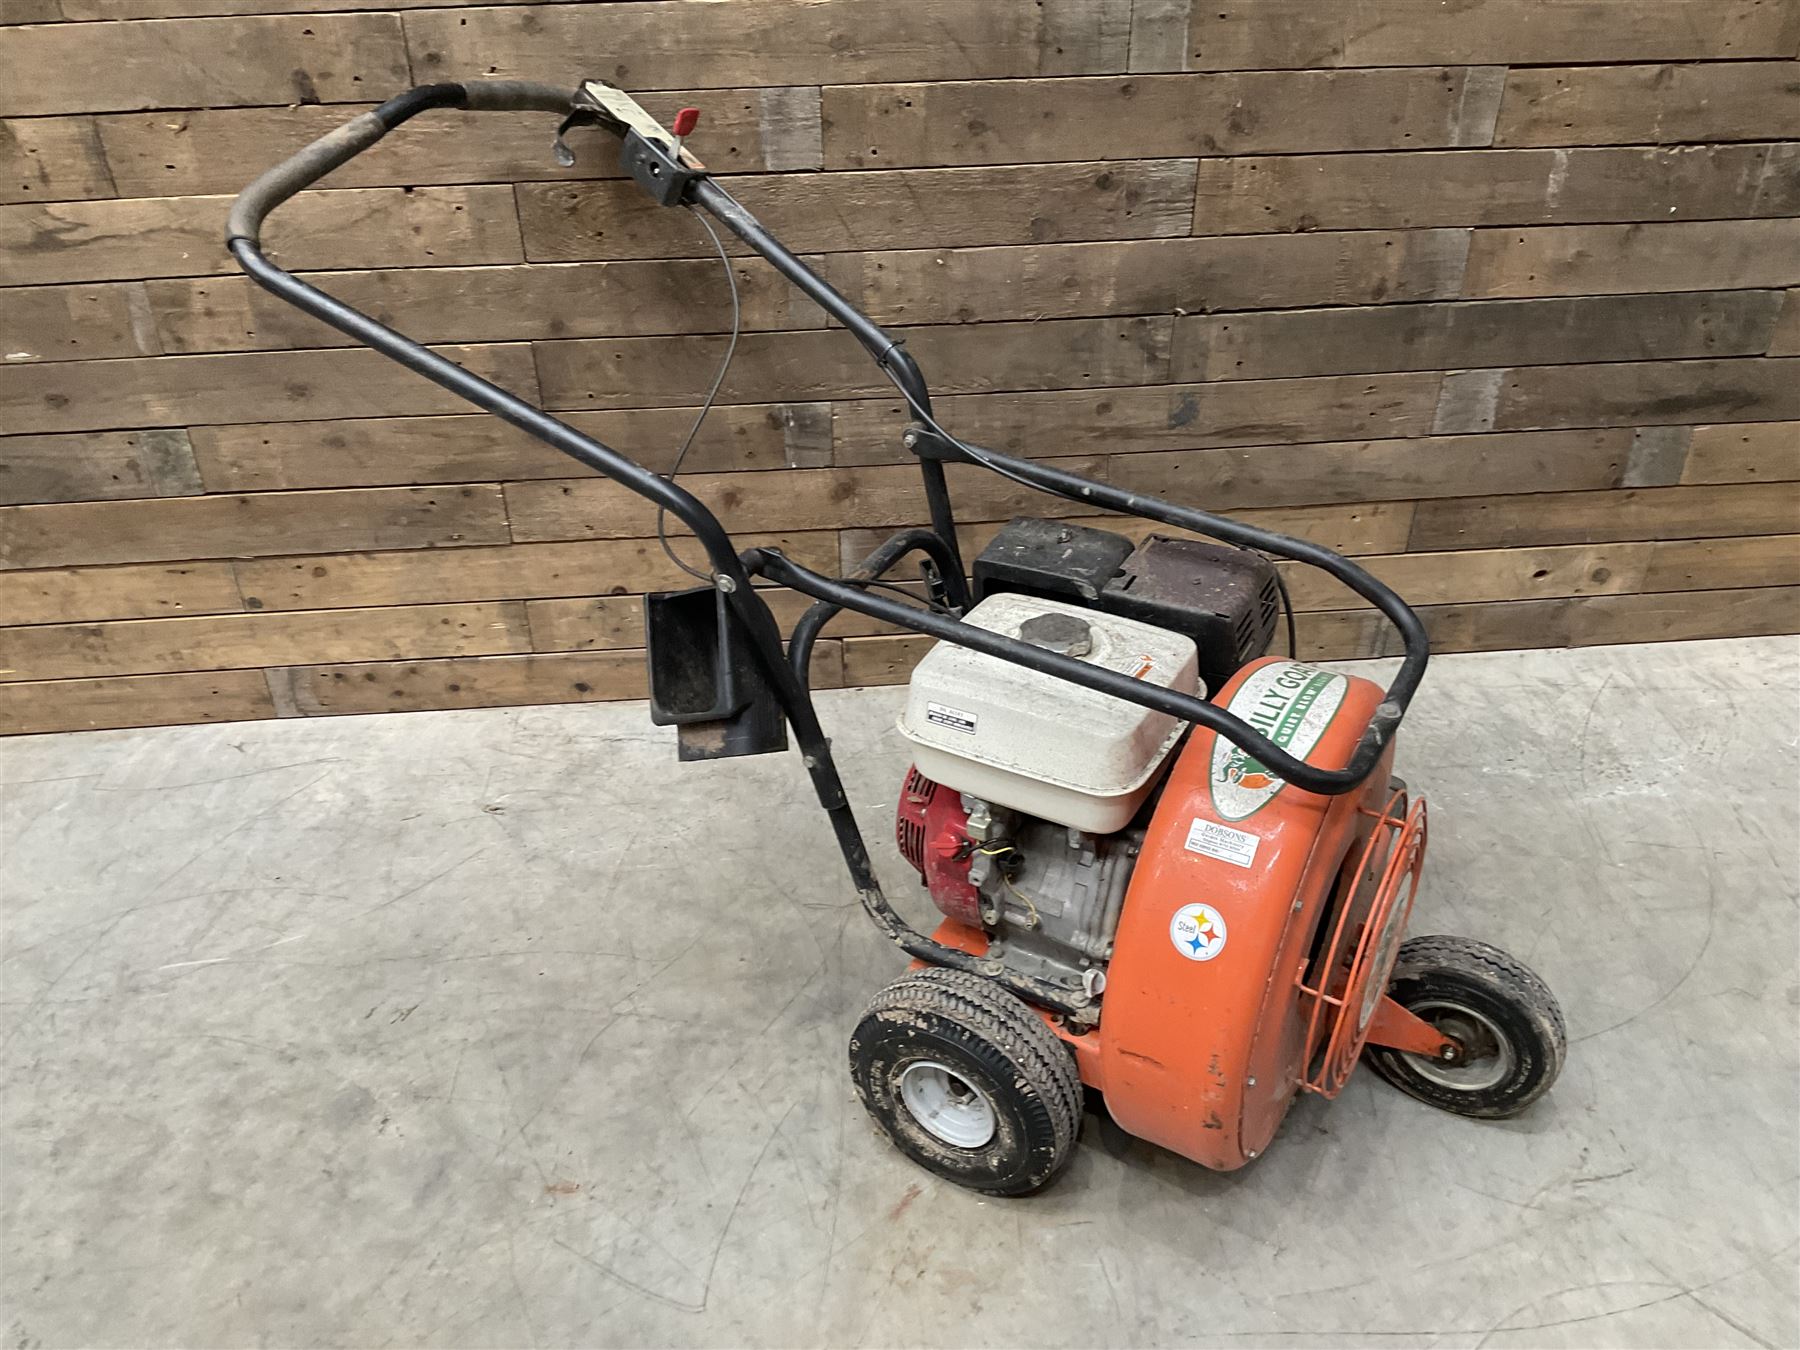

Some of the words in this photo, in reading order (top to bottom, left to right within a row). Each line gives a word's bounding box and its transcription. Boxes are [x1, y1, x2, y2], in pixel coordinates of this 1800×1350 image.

[1277, 712, 1301, 742] QUIET
[1205, 824, 1247, 843] DOBSONS
[1177, 921, 1196, 933] Steel
